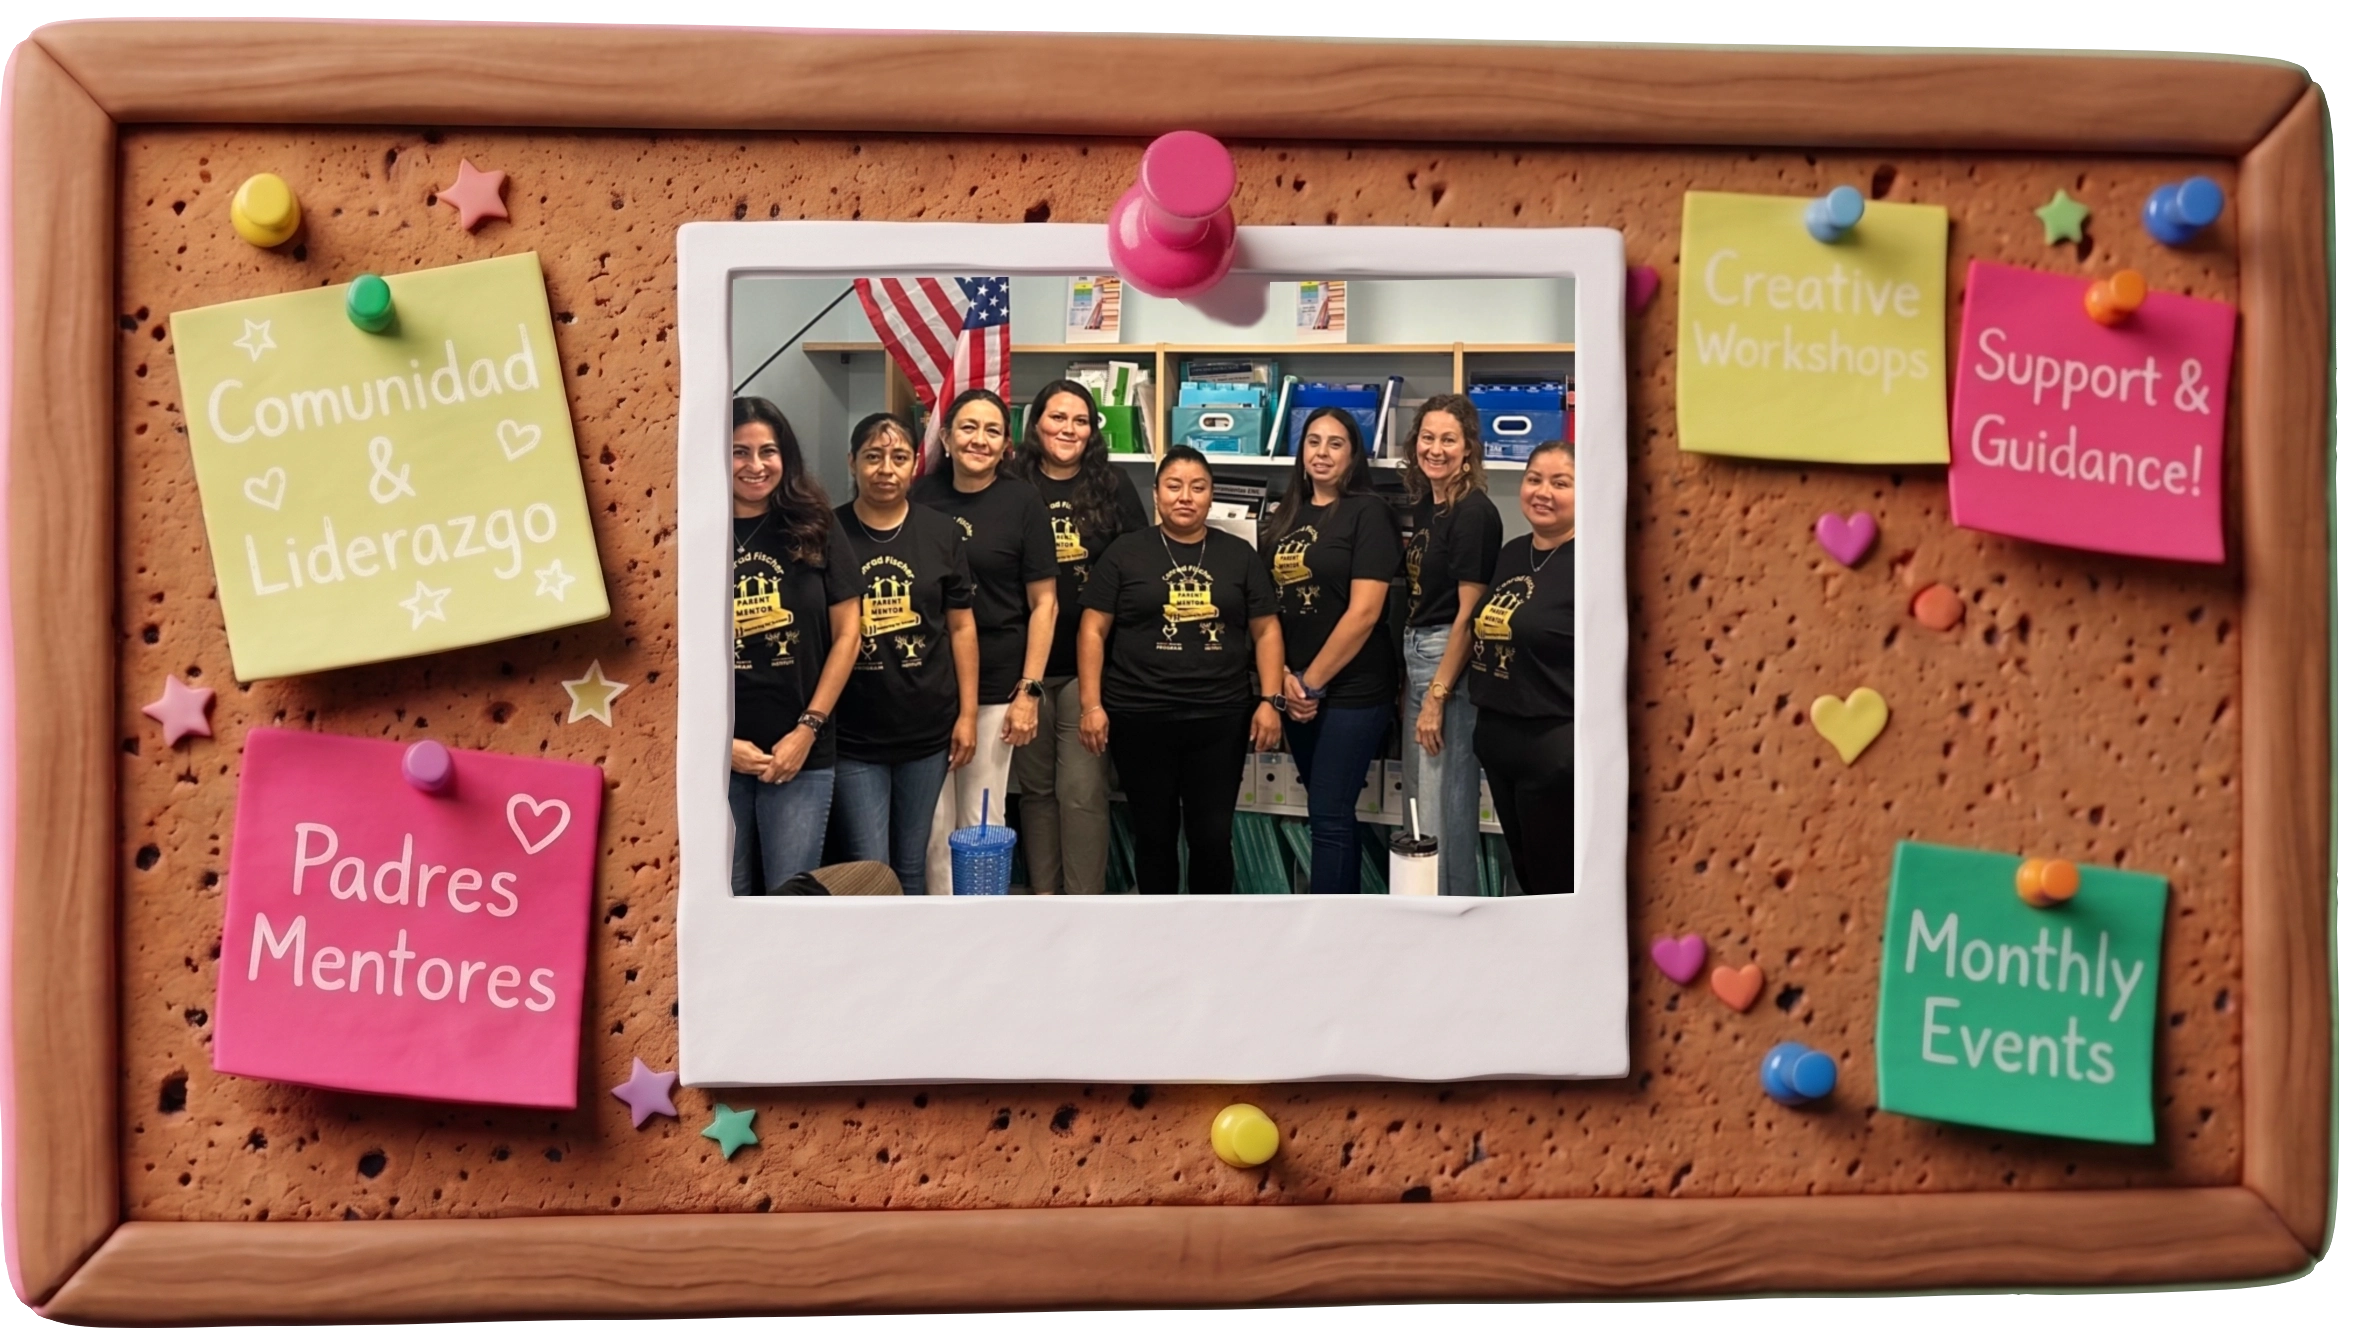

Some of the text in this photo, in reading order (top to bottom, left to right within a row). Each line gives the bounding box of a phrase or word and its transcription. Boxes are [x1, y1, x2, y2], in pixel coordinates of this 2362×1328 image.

[1704, 248, 1922, 318] Creative
[208, 323, 540, 444] Comunidad
[1692, 321, 1930, 394] Workshops
[1974, 327, 2211, 415] Support &
[368, 436, 417, 504] &
[1971, 413, 2203, 497] Guidance!
[245, 503, 557, 596] Liderazgo
[734, 551, 785, 575] rad Fischer
[861, 555, 915, 579] nrad Fischer
[736, 605, 773, 617] MENTOR
[737, 595, 770, 607] PARENT
[871, 606, 904, 615] MENTOR
[872, 598, 902, 607] PARENT
[1484, 615, 1504, 625] MENTOR
[1489, 607, 1508, 616] PARENT
[293, 822, 519, 917] Padres
[248, 912, 556, 1012] Mentores
[1905, 908, 2144, 1022] Monthly
[1922, 996, 2116, 1084] Events
